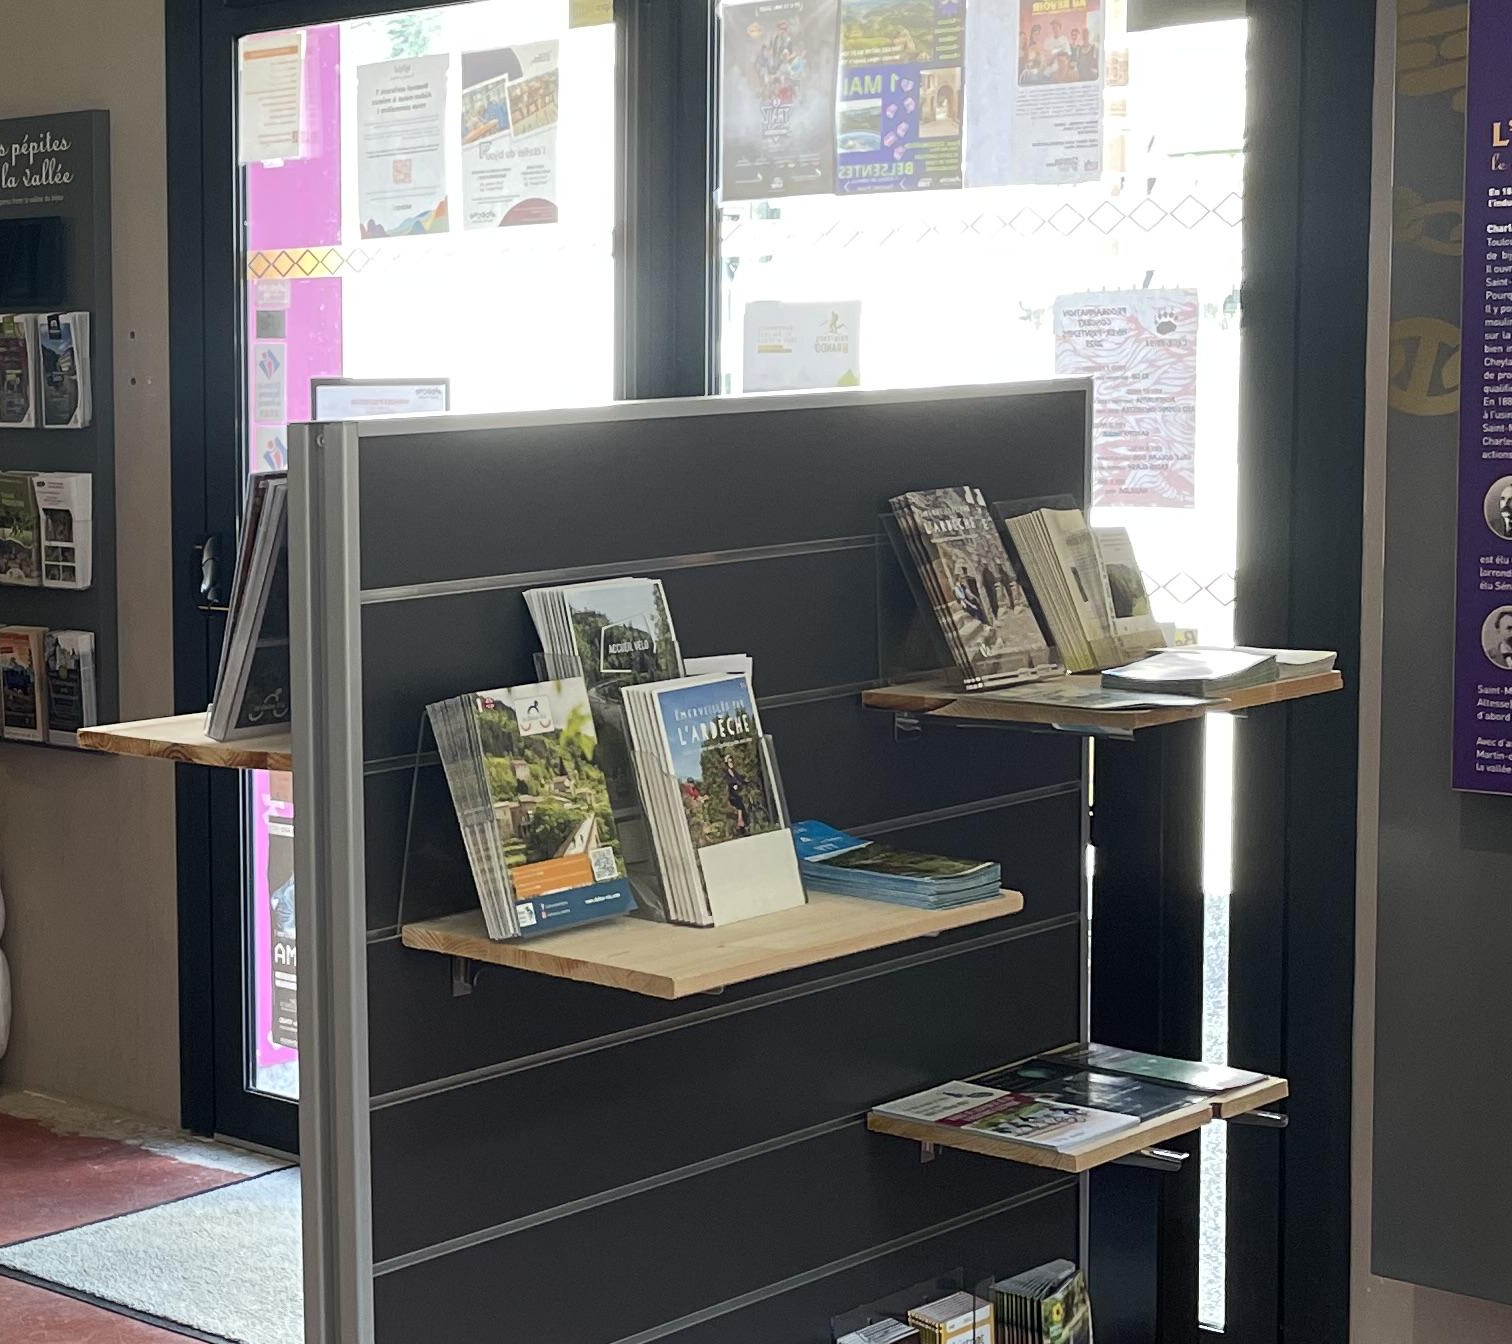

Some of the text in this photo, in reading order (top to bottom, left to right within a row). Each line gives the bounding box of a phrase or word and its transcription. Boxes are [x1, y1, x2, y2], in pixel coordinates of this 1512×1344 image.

[12, 131, 71, 166] pépites
[2, 162, 19, 188] la
[23, 158, 74, 186] vallée
[1486, 252, 1496, 260] de
[1484, 331, 1510, 340] sur la
[1484, 344, 1502, 353] bien
[1483, 370, 1494, 379] de
[1483, 396, 1494, 406] En
[1479, 555, 1492, 564] est
[677, 714, 750, 746] L'ARDÈCHE
